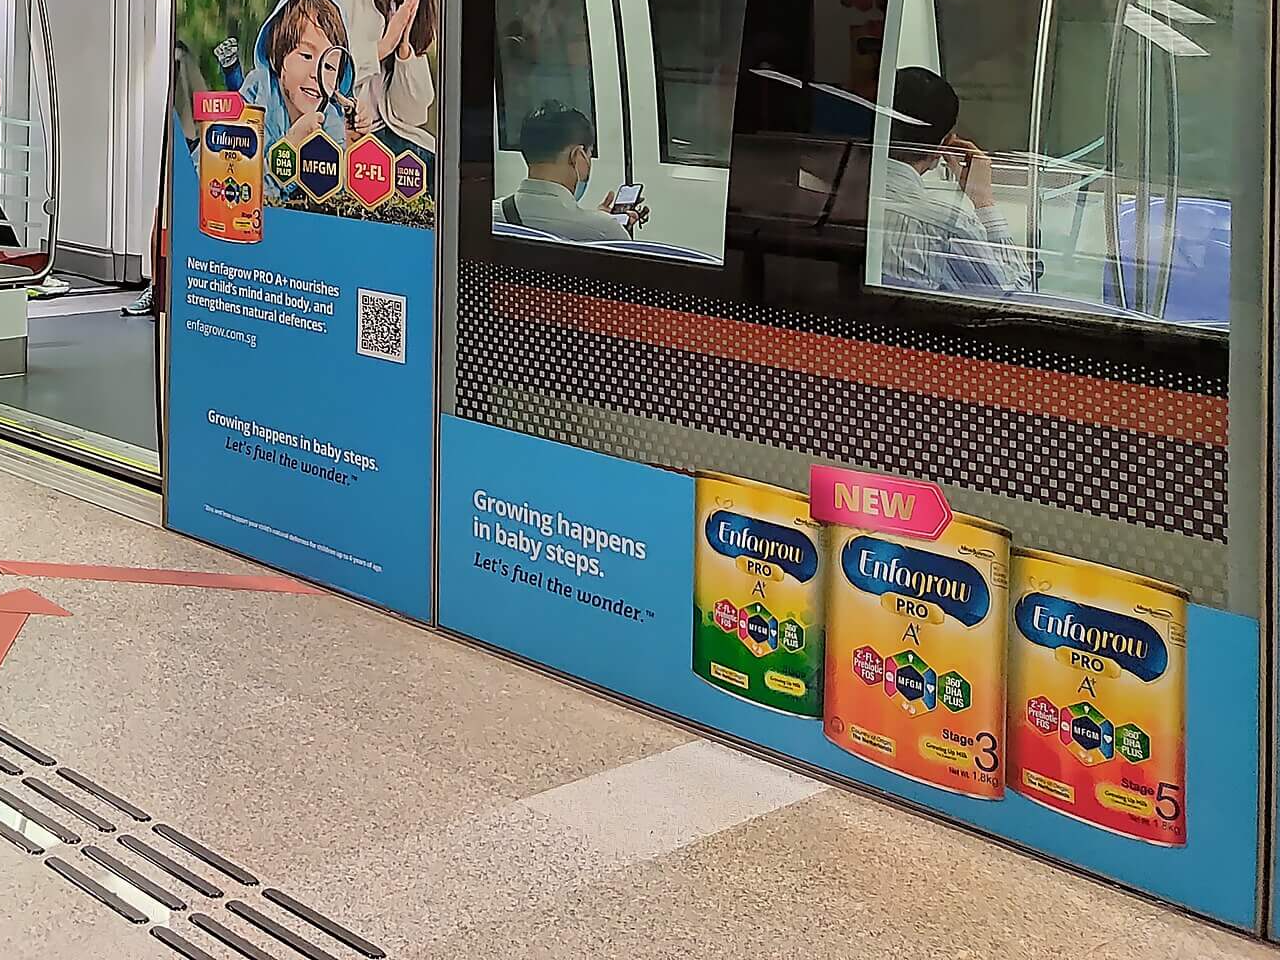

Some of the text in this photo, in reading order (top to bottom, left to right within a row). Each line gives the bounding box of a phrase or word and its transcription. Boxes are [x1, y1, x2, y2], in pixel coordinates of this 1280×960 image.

[202, 98, 233, 114] NEW
[276, 158, 292, 168] DHA
[277, 149, 290, 159] 360
[276, 167, 292, 177] PLUS
[302, 159, 337, 176] MFGM
[397, 167, 414, 175] IRON
[397, 176, 420, 187] ZINC
[252, 209, 261, 229] 3
[187, 257, 340, 298] New Enfagrow PRO A+ nourishes
[187, 277, 334, 315] your child's mind and body, and
[187, 293, 241, 315] strengthens
[242, 305, 277, 323] natural
[186, 319, 257, 348] enfagrow.com.sg
[208, 409, 379, 471] Growing happens in baby steps.
[225, 437, 251, 456] Let's
[252, 444, 276, 464] fuel
[279, 449, 298, 470] the
[834, 482, 916, 521] NEW
[473, 489, 647, 560] Growing happens
[473, 516, 605, 577] in baby steps.
[718, 521, 804, 564] Enfagrow
[474, 552, 509, 576] Let's
[511, 565, 543, 588] fuel
[547, 577, 572, 598] the
[747, 560, 772, 576] PRO
[860, 548, 972, 603] Enfagrow
[896, 597, 928, 619] PRO
[749, 623, 768, 635] MFGM
[901, 622, 921, 646] A+
[1032, 605, 1149, 659] Enfagrow
[783, 637, 799, 648] PLUS
[854, 658, 883, 674] Prebiotic
[1071, 651, 1104, 673] PRO
[861, 669, 875, 681] FOS
[898, 676, 922, 691] MFGM
[945, 687, 962, 698] DHA
[1077, 676, 1097, 698] A+
[943, 695, 964, 708] PLUS
[1028, 708, 1058, 724] Prebiotic
[1036, 719, 1050, 730] FOS
[942, 728, 974, 746] Stage
[1073, 726, 1099, 740] MFGM
[974, 732, 999, 772] 3
[1121, 745, 1143, 759] PLUS
[1123, 737, 1141, 749] DHA
[956, 750, 968, 759] Milk
[1121, 777, 1154, 796] Stage
[1155, 782, 1180, 821] 5
